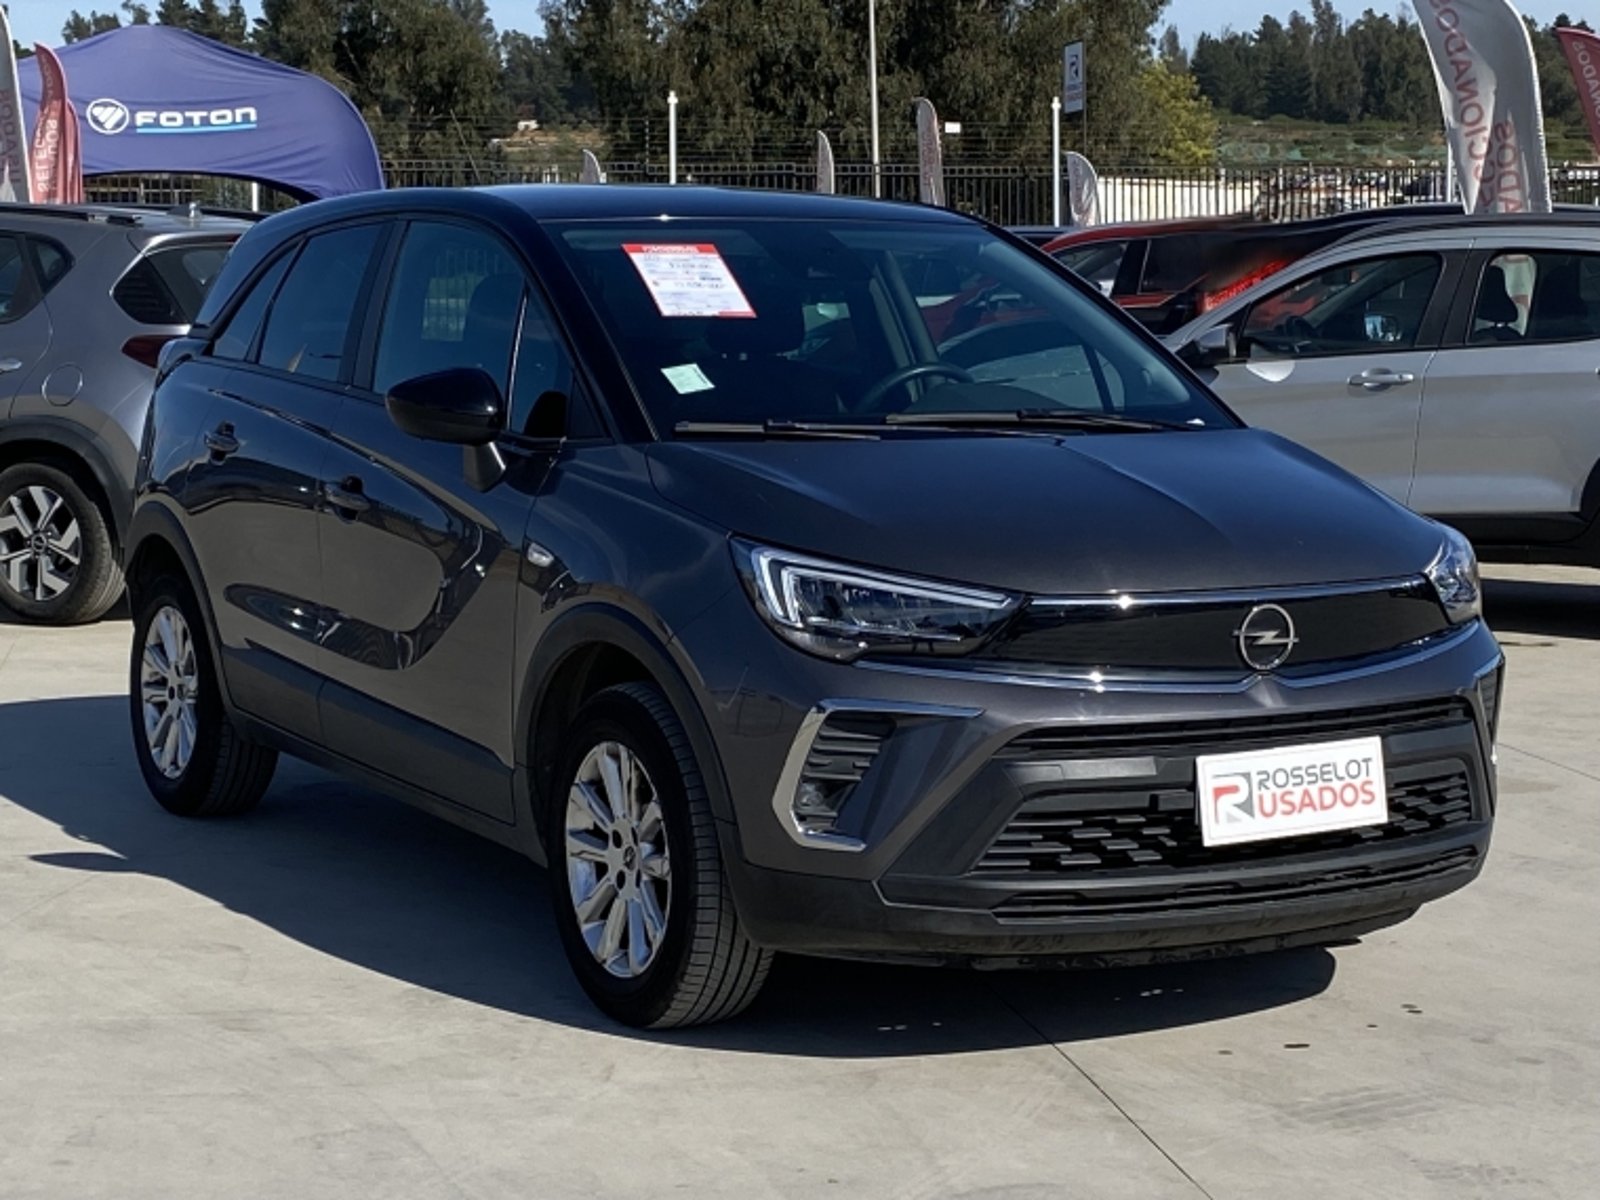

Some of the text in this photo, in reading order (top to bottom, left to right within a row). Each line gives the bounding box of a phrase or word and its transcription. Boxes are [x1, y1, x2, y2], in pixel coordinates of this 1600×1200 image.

[135, 106, 257, 127] FOTON
[1256, 757, 1373, 792] ROSSELOT
[1258, 780, 1376, 819] USADOS
